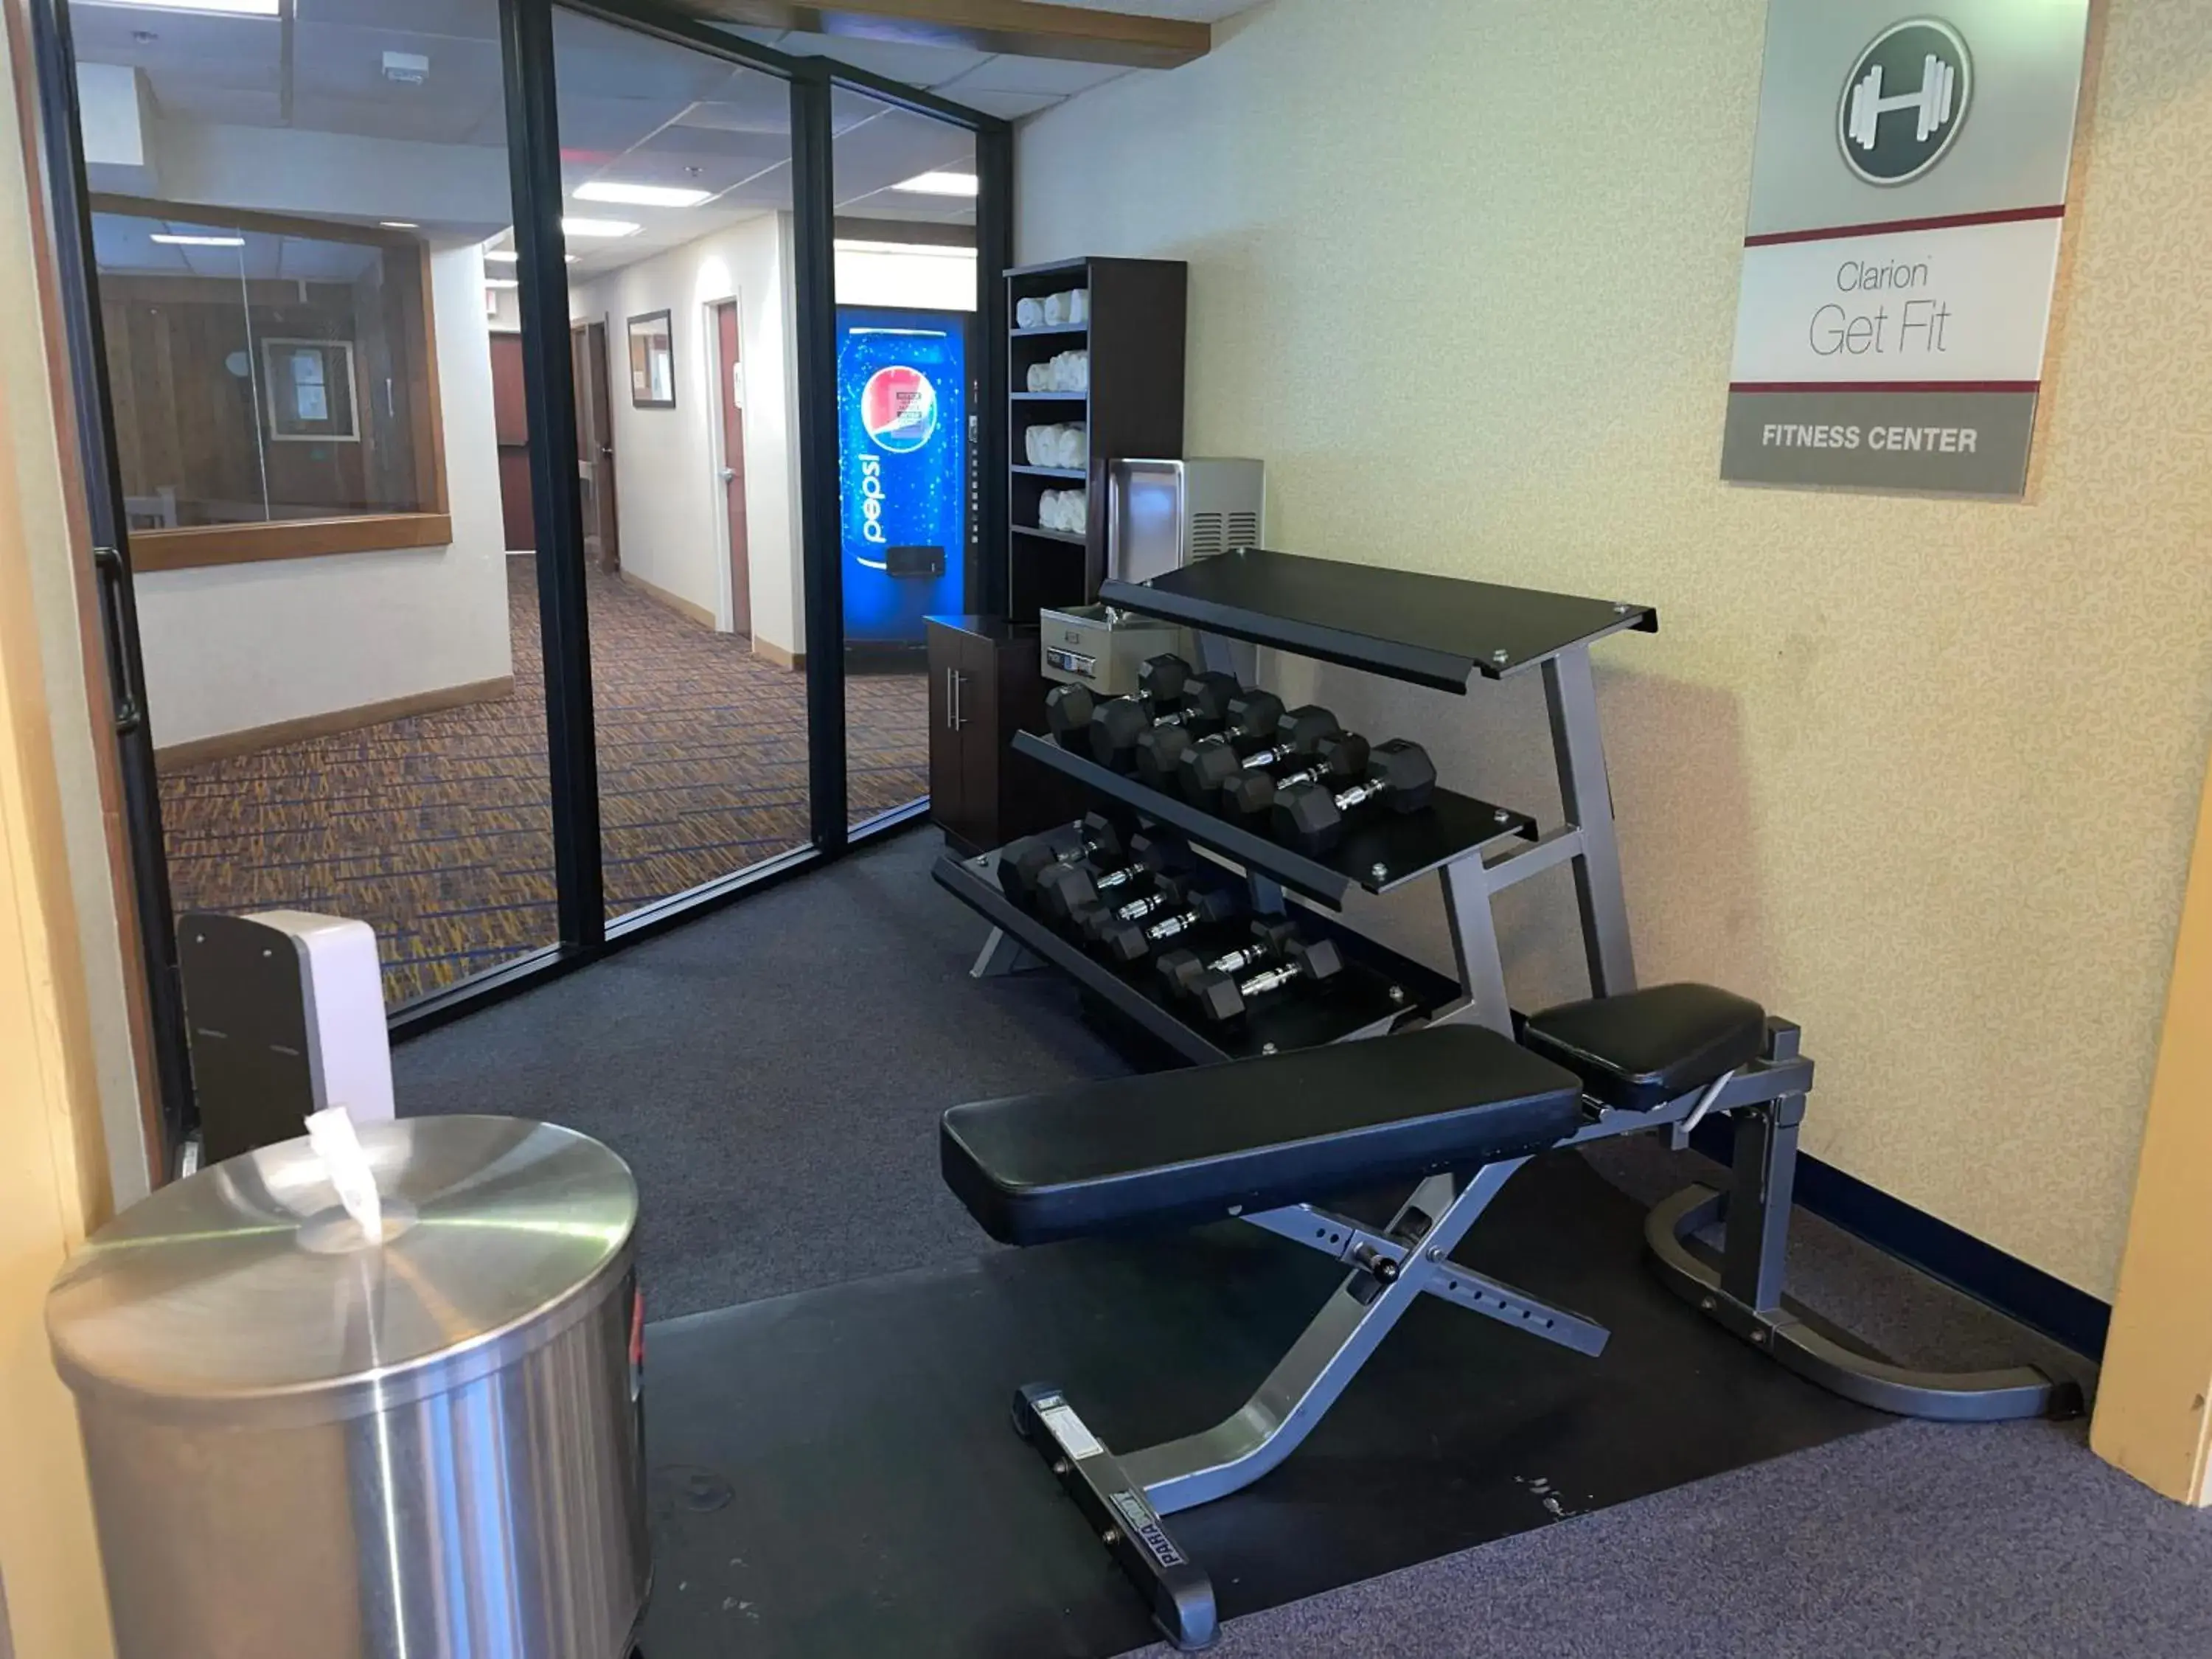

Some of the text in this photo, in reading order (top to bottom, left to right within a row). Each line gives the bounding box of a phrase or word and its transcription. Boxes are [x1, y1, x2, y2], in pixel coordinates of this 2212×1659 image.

[1837, 260, 1928, 291] Clarion
[1809, 299, 1952, 355] Get Fit
[1762, 424, 1978, 453] FITNESS CENTER
